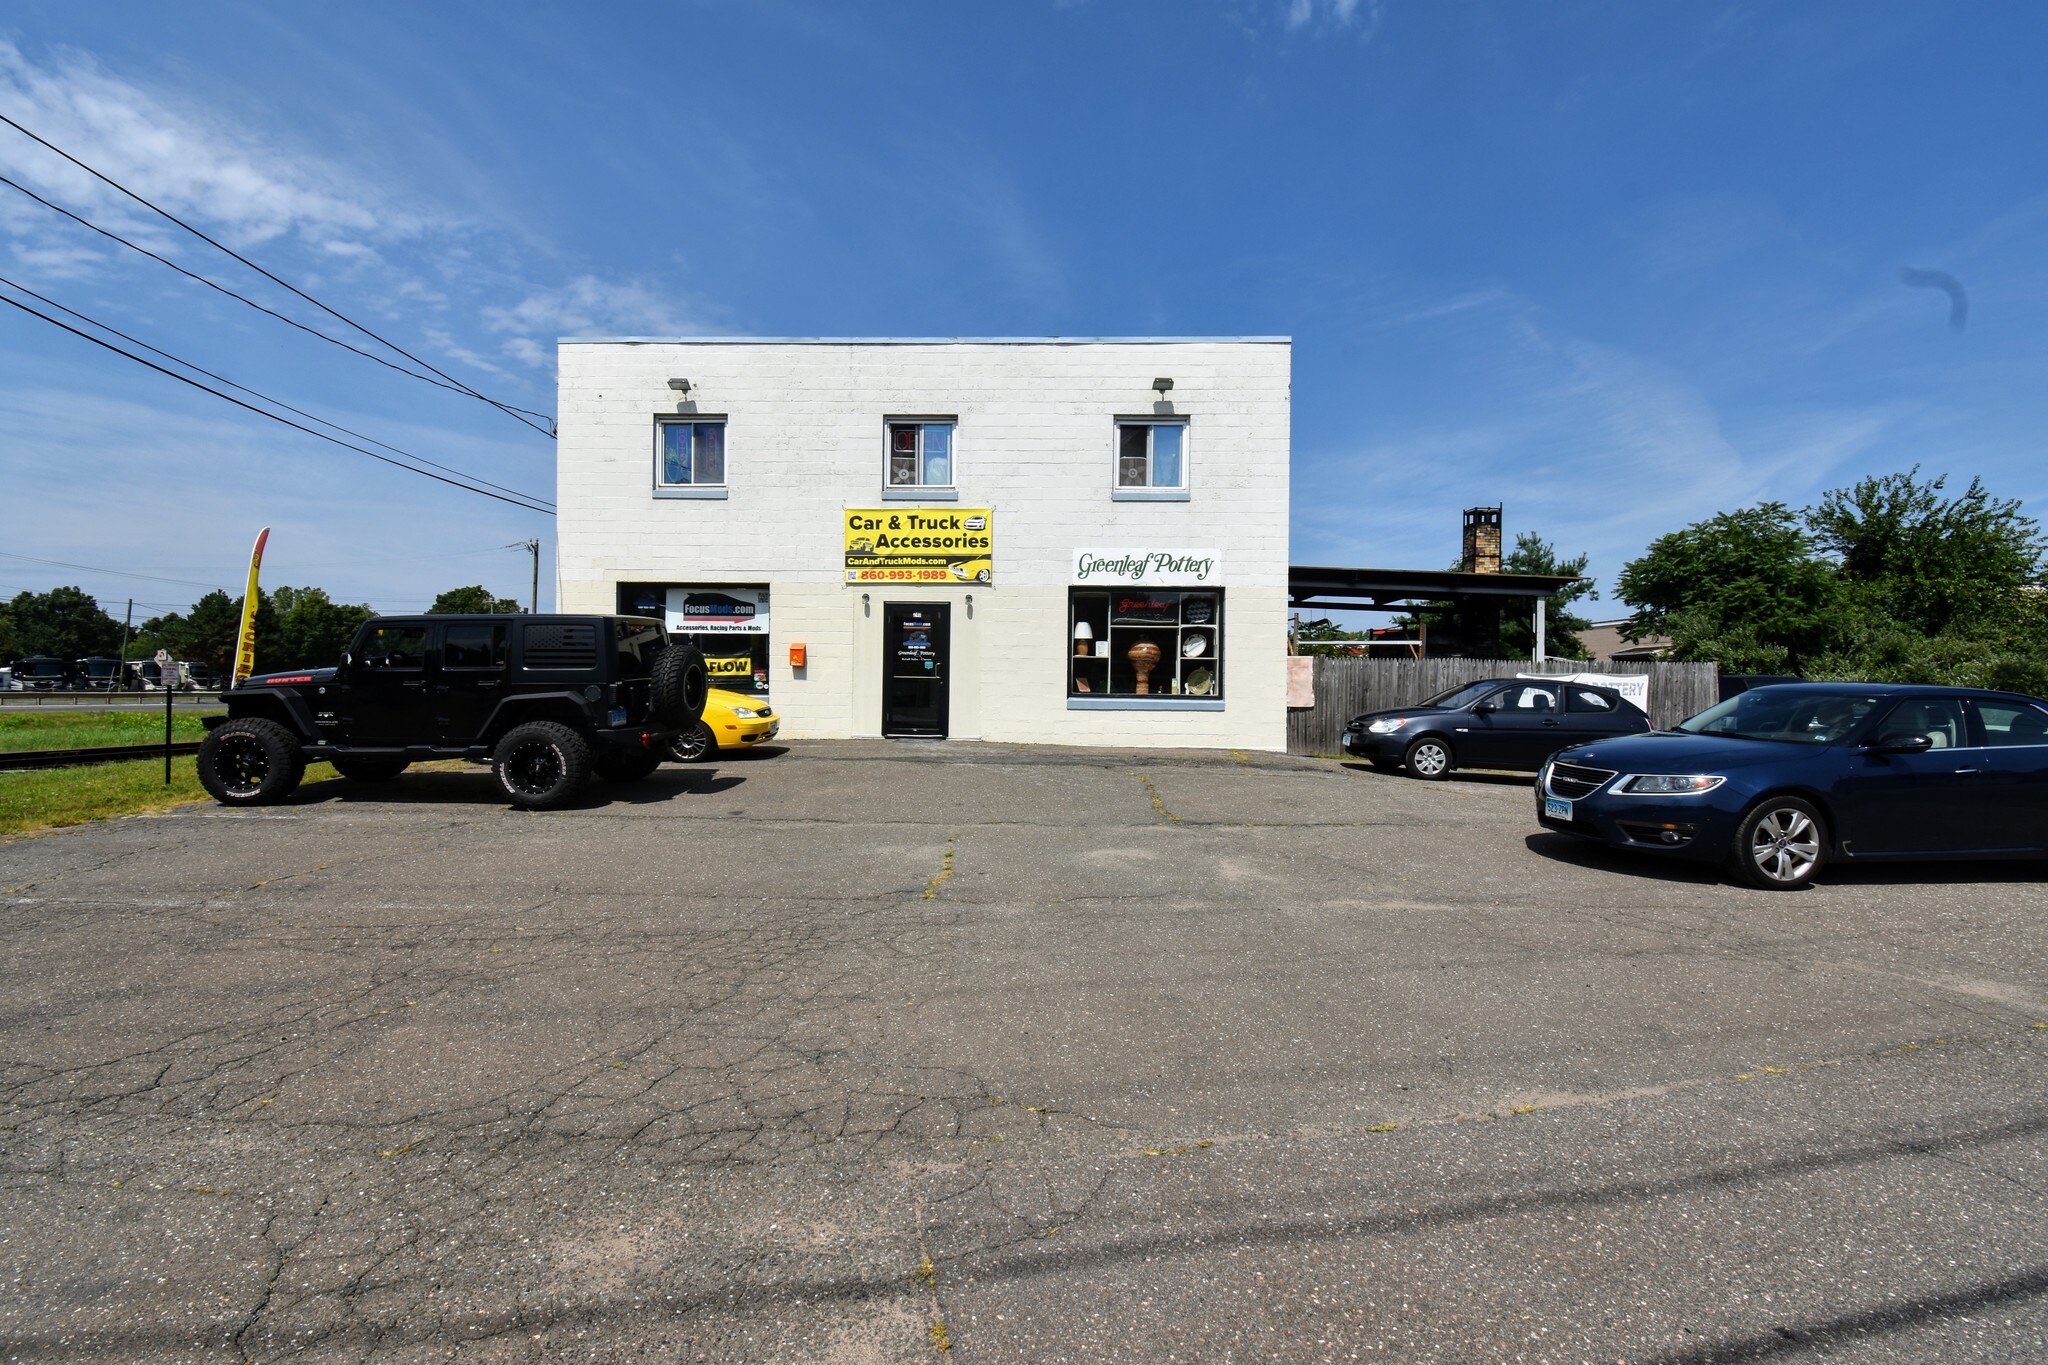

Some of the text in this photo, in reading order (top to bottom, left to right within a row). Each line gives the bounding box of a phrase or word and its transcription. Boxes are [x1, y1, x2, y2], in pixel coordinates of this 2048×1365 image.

[849, 514, 961, 530] Car & Truck
[875, 533, 989, 548] Accessories
[847, 557, 947, 566] CarAndTruckMods.com
[1077, 552, 1214, 580] Greenleaf Pottery
[860, 570, 947, 580] 860-993-1989
[684, 604, 754, 614] FocusMods.com
[676, 624, 709, 632] Accessories,
[710, 624, 728, 632] Racing
[729, 624, 743, 632] Parts
[748, 624, 762, 632] Mods
[266, 676, 312, 684] HUNTER
